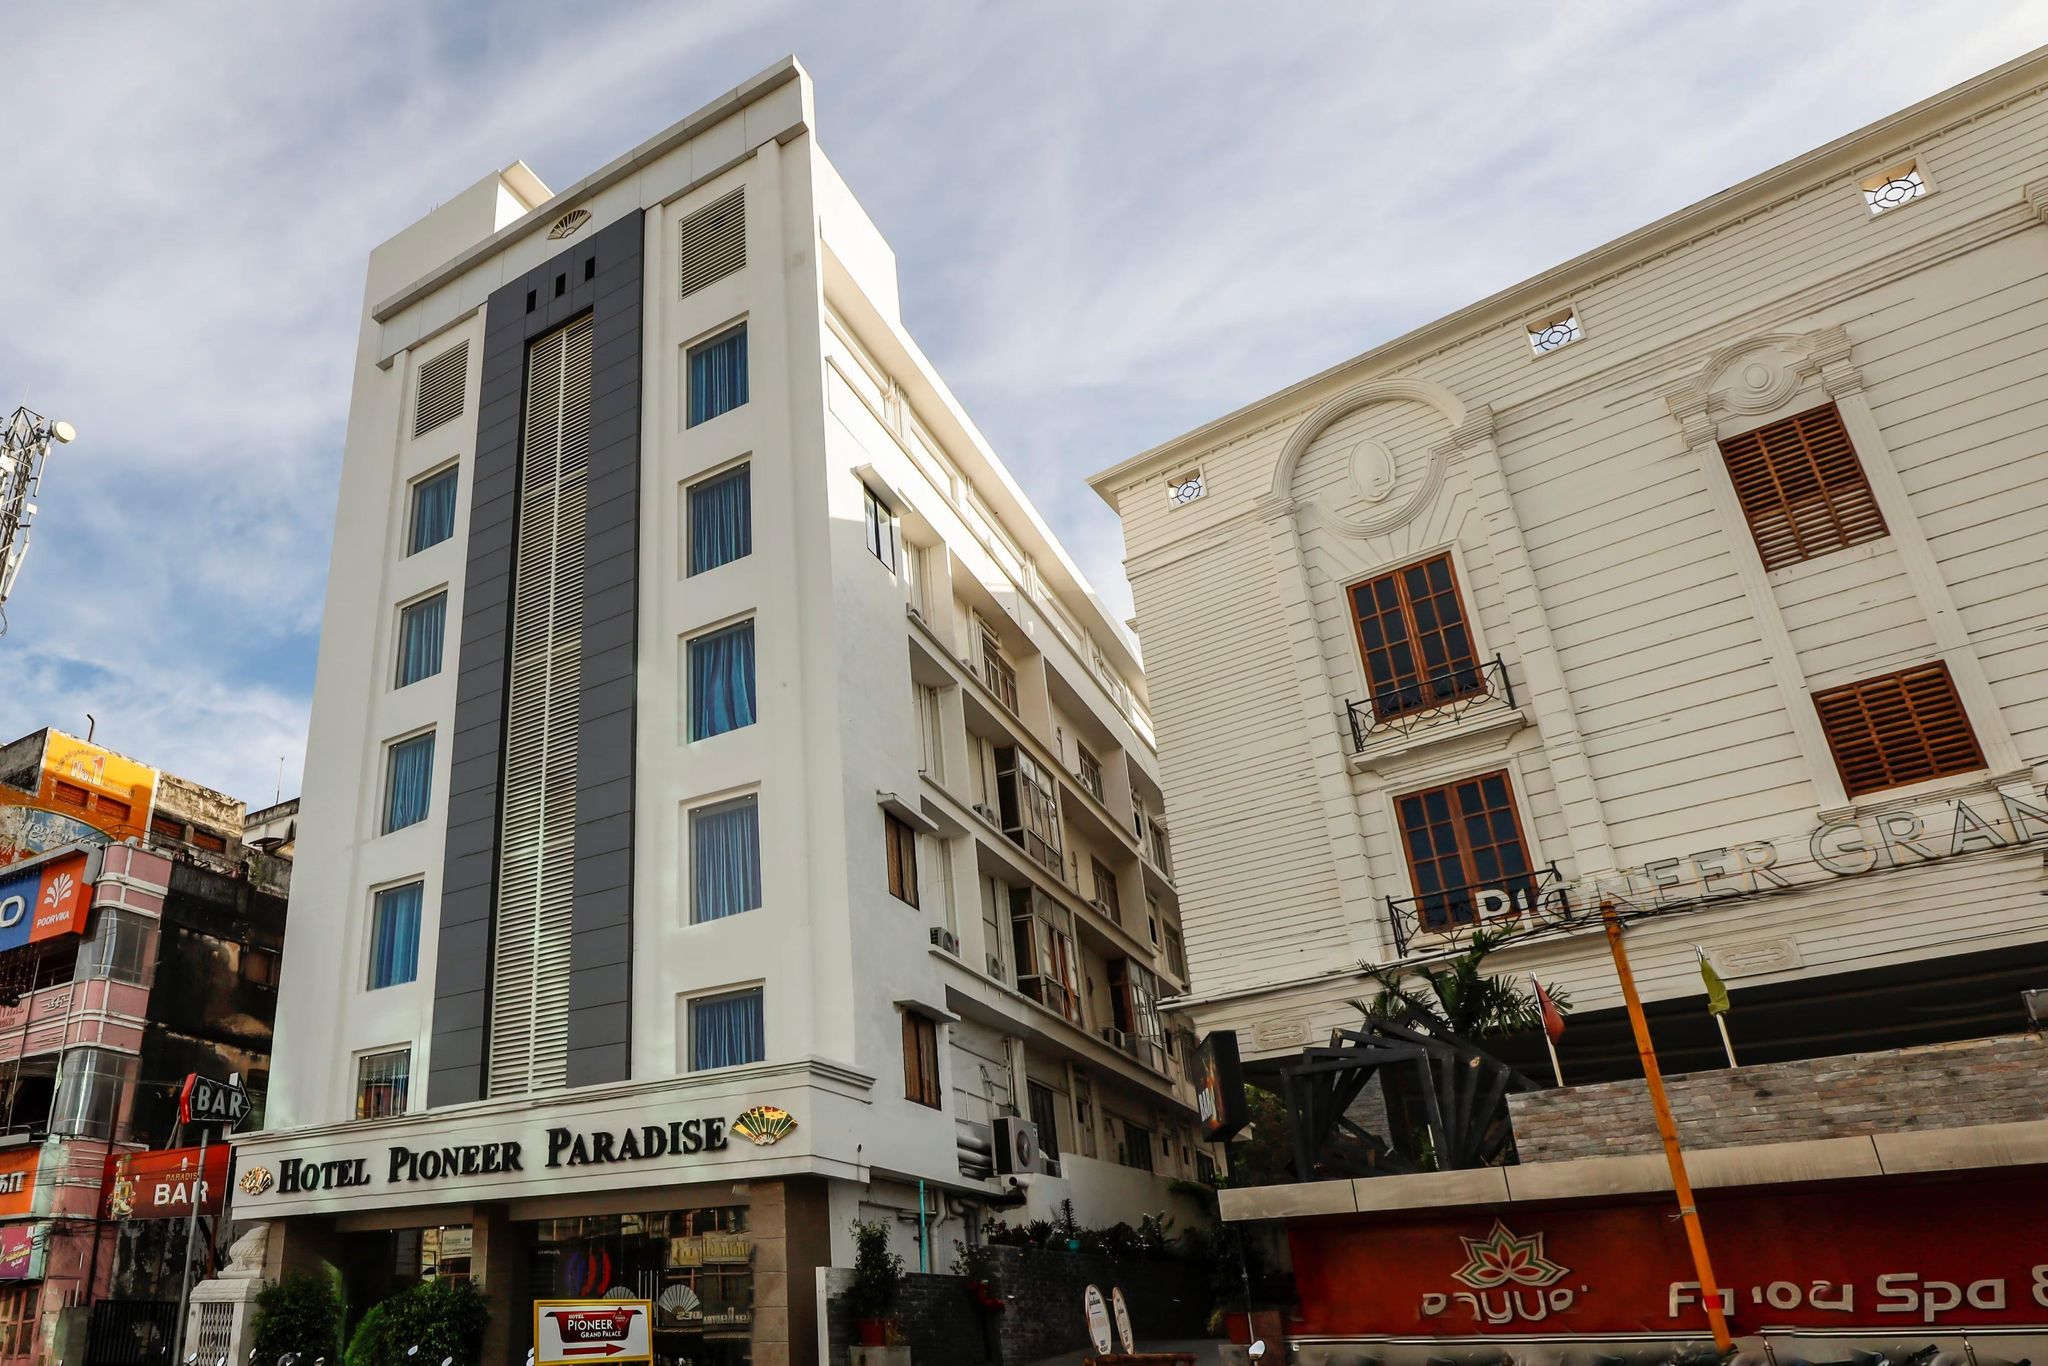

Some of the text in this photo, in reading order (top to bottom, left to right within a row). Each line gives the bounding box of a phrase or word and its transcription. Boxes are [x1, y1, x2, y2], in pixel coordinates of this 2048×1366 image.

[36, 911, 70, 929] POORVIKA
[197, 1085, 243, 1118] BAR
[276, 1116, 729, 1194] HOTEL PIONEER PARADISE
[165, 1172, 201, 1182] PARADIS
[153, 1180, 209, 1206] BAR
[1876, 1272, 2006, 1323] Spa
[567, 1319, 614, 1331] PIONEER
[580, 1329, 622, 1339] GRAND PALACE
